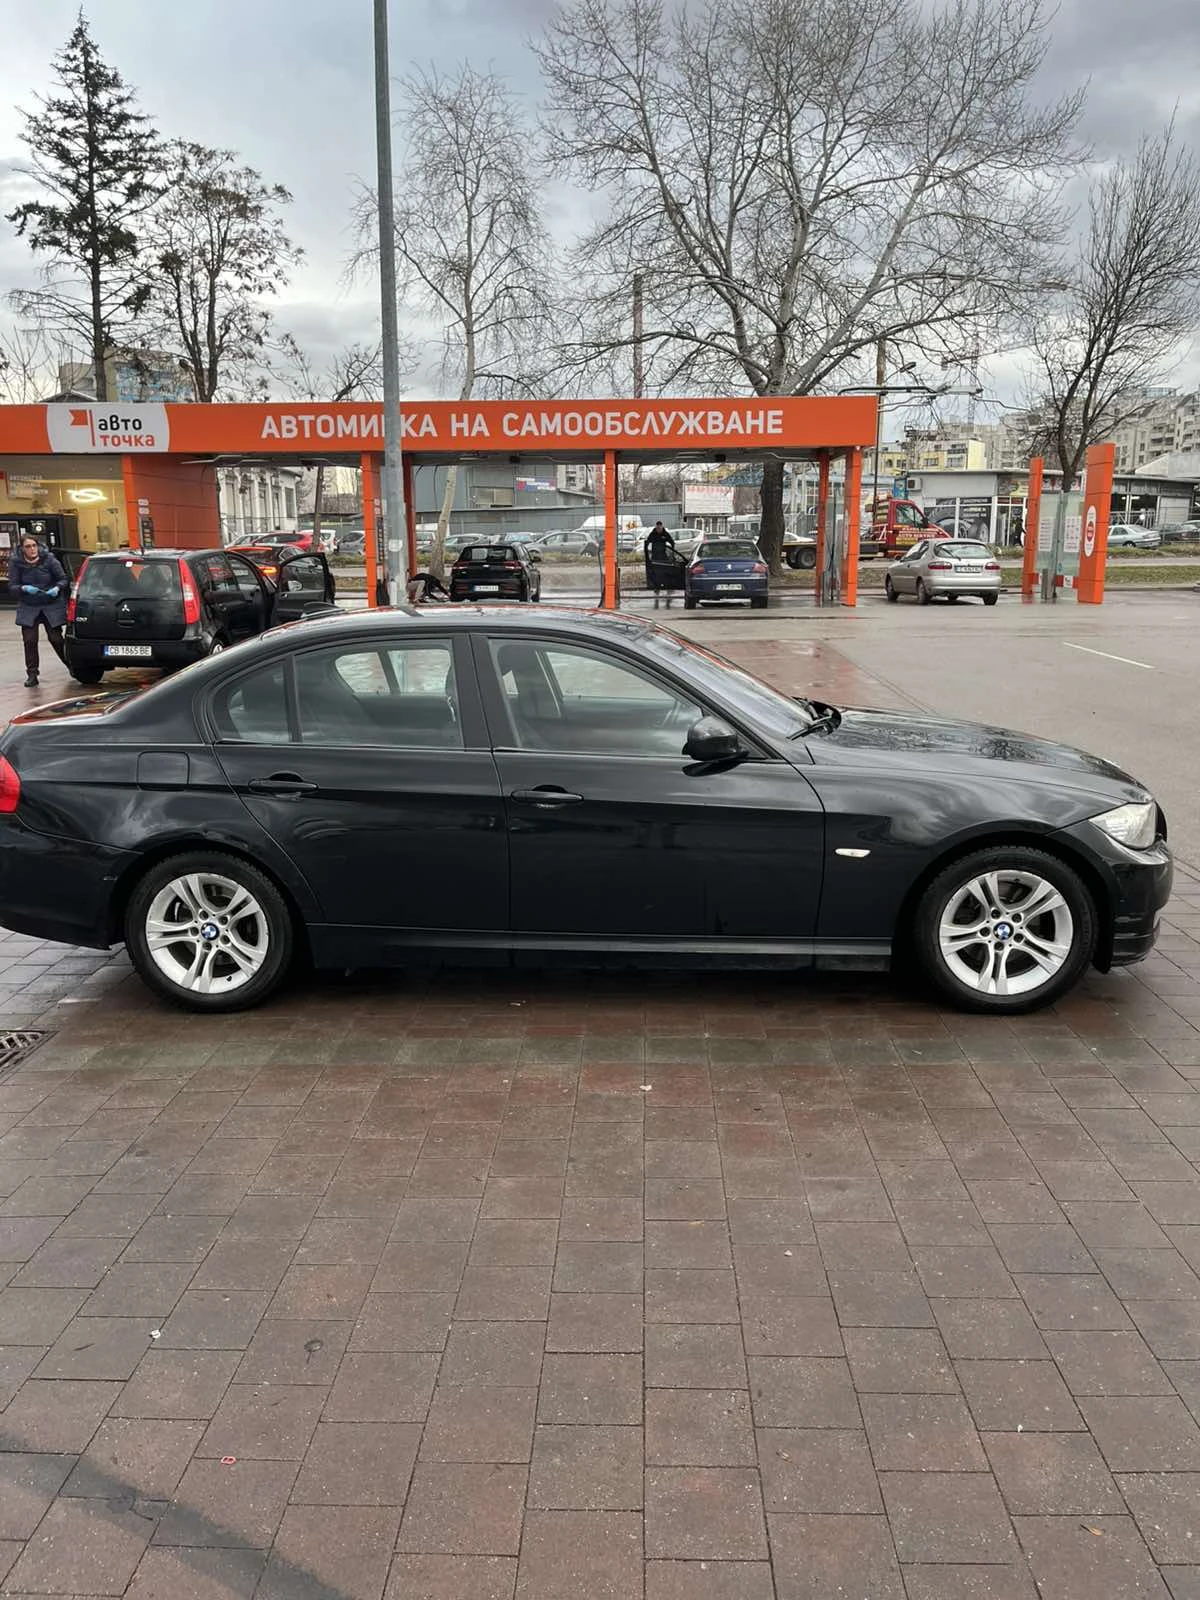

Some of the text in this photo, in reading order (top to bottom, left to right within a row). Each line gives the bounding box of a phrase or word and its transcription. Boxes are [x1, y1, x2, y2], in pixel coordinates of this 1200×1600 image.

[262, 410, 784, 439] АВТОМИКА НА САМООБСЛУЖВАНЕ
[100, 434, 155, 448] точка
